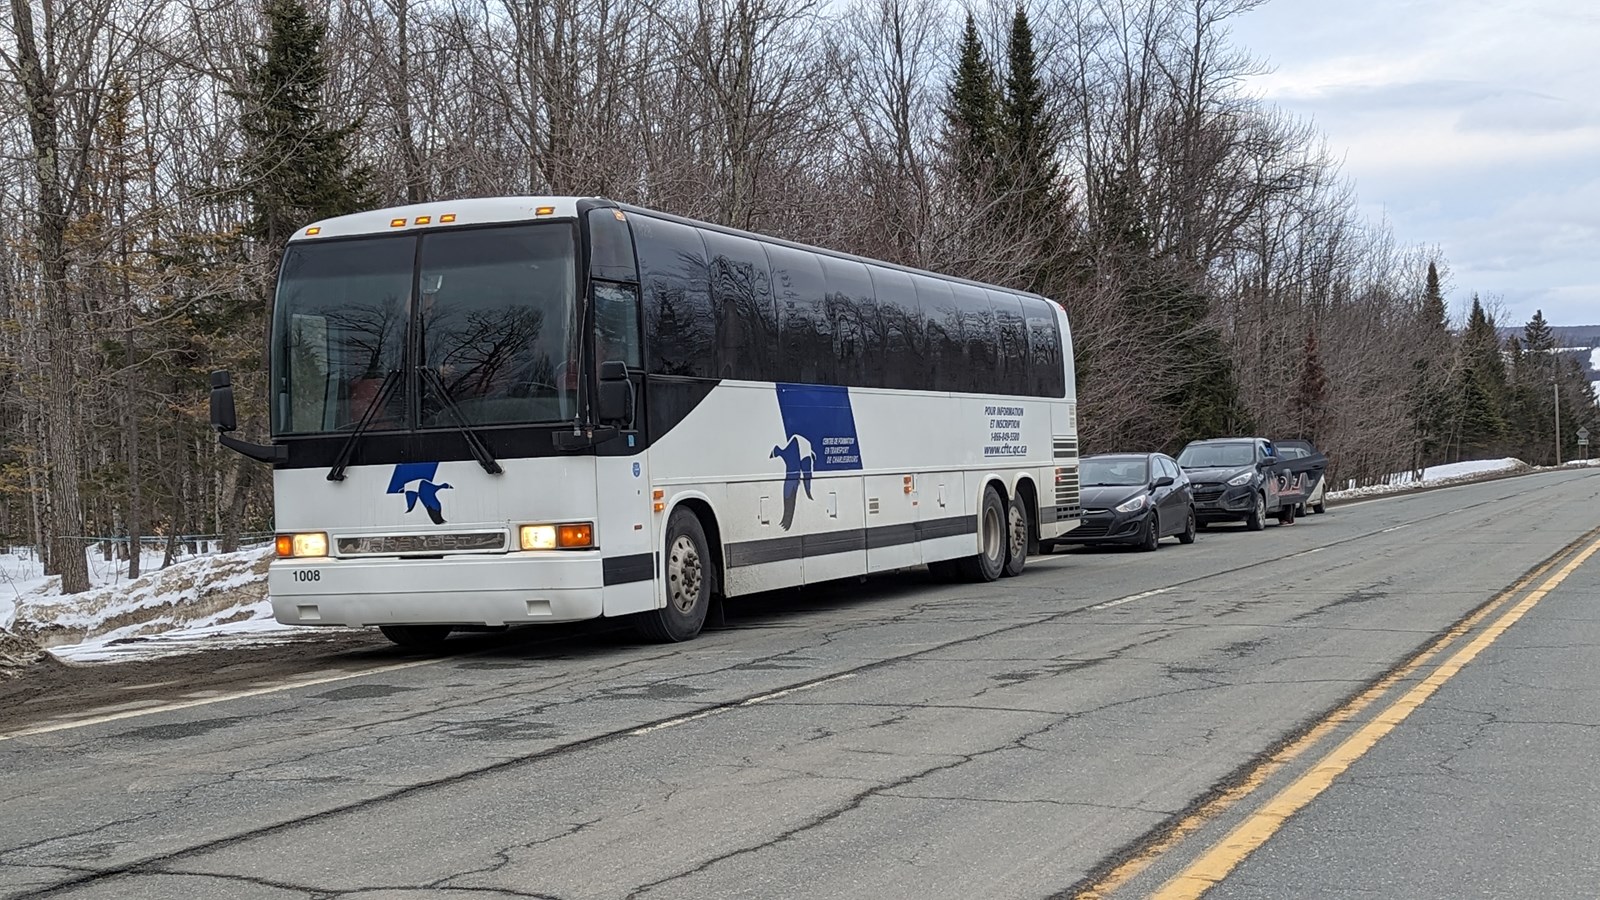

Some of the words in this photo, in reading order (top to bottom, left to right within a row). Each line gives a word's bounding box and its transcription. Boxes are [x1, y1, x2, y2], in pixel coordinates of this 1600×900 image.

[985, 406, 996, 415] POUR
[997, 406, 1024, 416] INFORMATION
[990, 419, 995, 428] ET
[996, 419, 1020, 428] INSCRIPTION
[984, 442, 1027, 455] www.cftc.qc.ca
[292, 569, 321, 582] 1008
